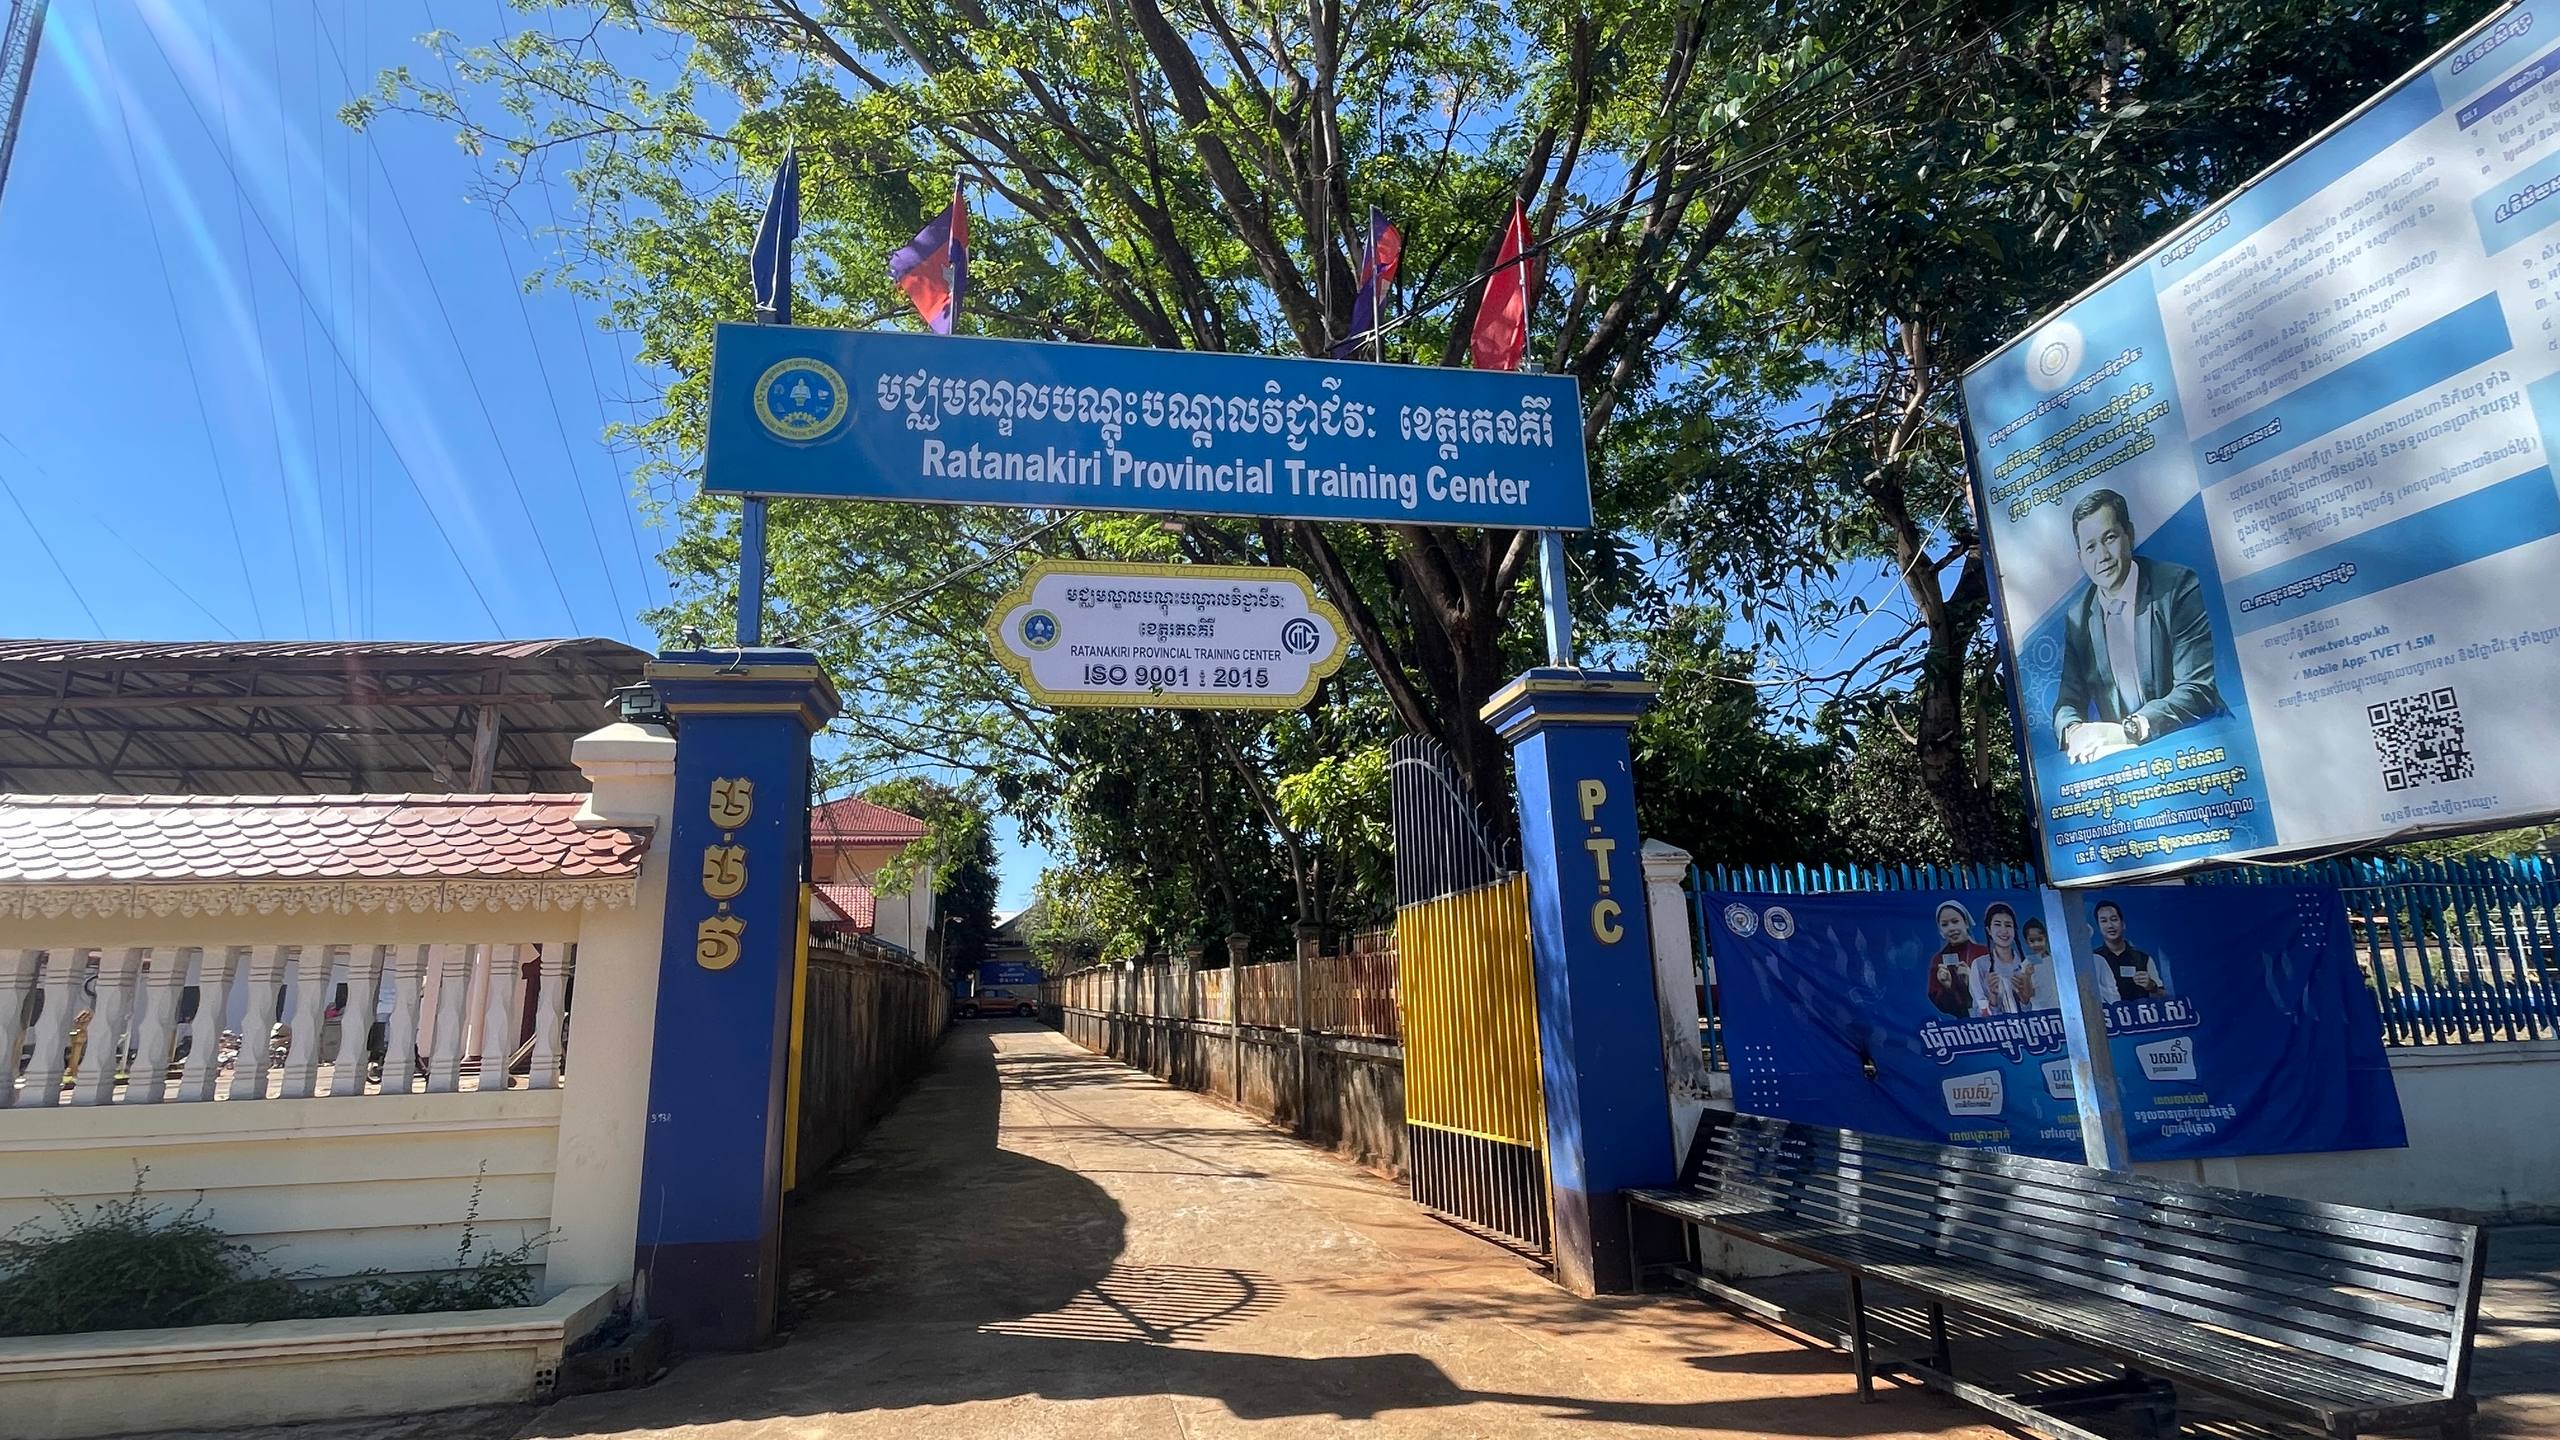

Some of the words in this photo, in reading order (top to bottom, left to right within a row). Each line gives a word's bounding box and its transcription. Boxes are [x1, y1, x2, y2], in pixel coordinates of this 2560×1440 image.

[1400, 394, 1554, 461] ខេត្តរតនគិរី
[922, 439, 1102, 486] Ratanakiri
[1113, 450, 1273, 494] Provincial
[1285, 459, 1418, 509] Training
[1427, 465, 1530, 505] Center
[1139, 617, 1216, 643] ខេត្តរតនគិរី
[2297, 624, 2390, 660] www.tvet.gov.kh
[1070, 645, 1131, 658] RATANAKIRI
[1132, 646, 1192, 660] PROVINCIAL
[1194, 648, 1241, 661] TRAINING
[1243, 649, 1282, 662] CENTER
[2303, 661, 2338, 681] Mobile
[2341, 655, 2367, 672] App:
[2369, 643, 2402, 662] TVET
[2404, 633, 2436, 653] 1.5M
[1083, 664, 1128, 686] ISO
[1135, 666, 1189, 687] 9001
[1213, 667, 1269, 688] 2015
